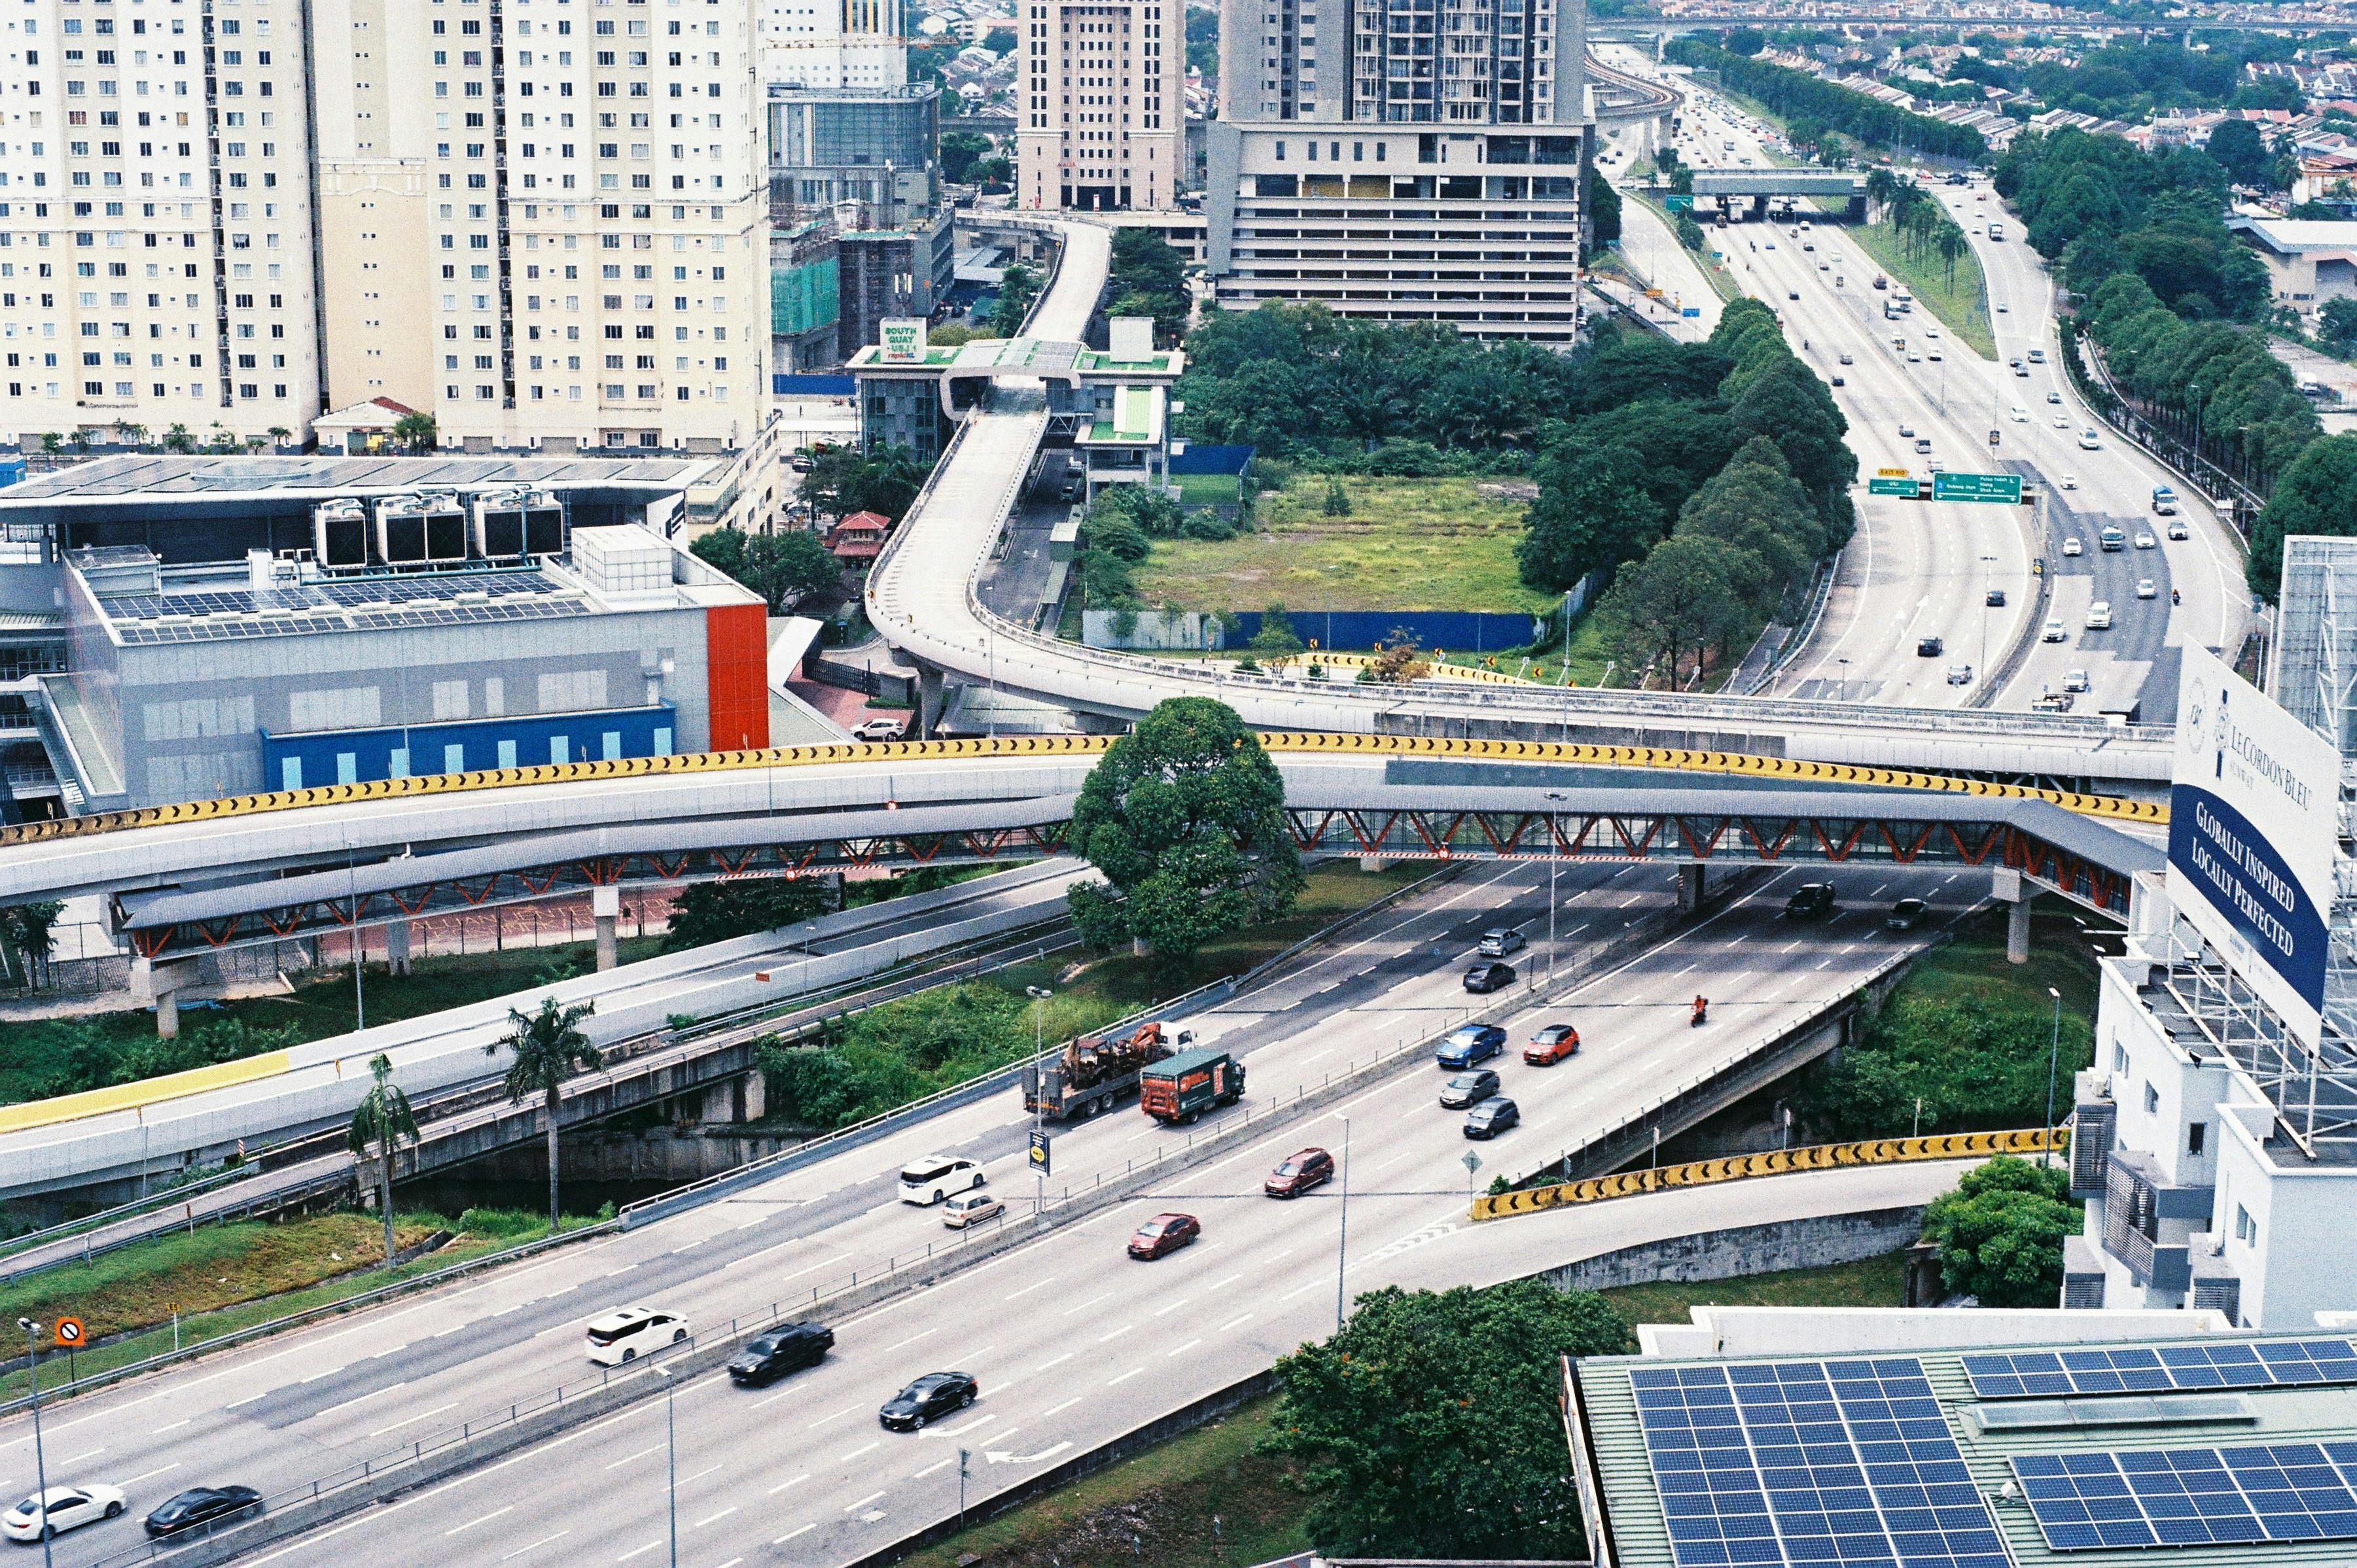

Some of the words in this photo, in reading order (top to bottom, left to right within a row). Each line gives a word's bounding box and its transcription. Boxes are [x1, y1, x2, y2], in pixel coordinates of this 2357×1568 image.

[2231, 725, 2242, 756] LE
[2243, 736, 2285, 787] CORDON
[2284, 769, 2308, 811] BLEU
[2192, 837, 2233, 898] LOCALLY
[2234, 879, 2294, 956] PERFECTED
[2196, 801, 2244, 865] GLOBALLY
[2244, 846, 2295, 913] INSPIRED
